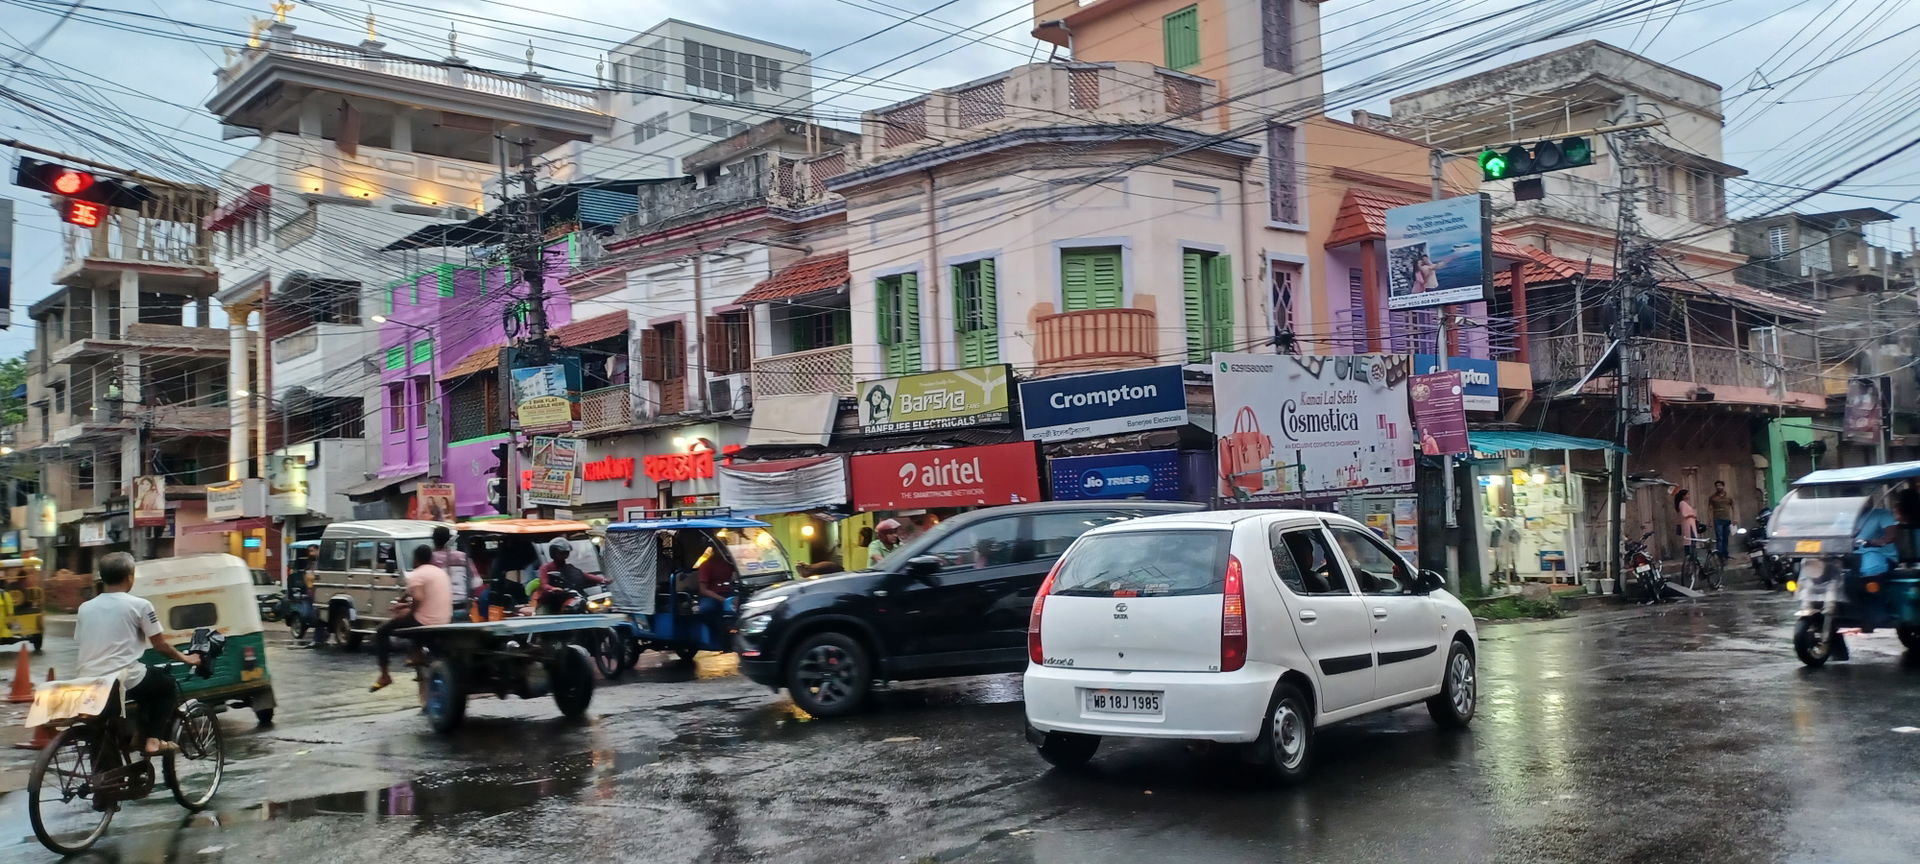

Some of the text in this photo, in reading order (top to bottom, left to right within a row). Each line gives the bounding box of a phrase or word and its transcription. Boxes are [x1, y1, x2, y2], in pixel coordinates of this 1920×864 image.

[900, 388, 965, 414] Barsha
[1050, 384, 1157, 409] Crompton
[1300, 389, 1358, 405] Kanai Lal Seth's
[912, 415, 976, 431] ELECTRICALS
[1280, 399, 1359, 442] Cosmetica
[921, 456, 983, 487] airtel
[1083, 475, 1150, 488] Jio TRUE 5G
[1094, 694, 1159, 710] WB 18J 1985
